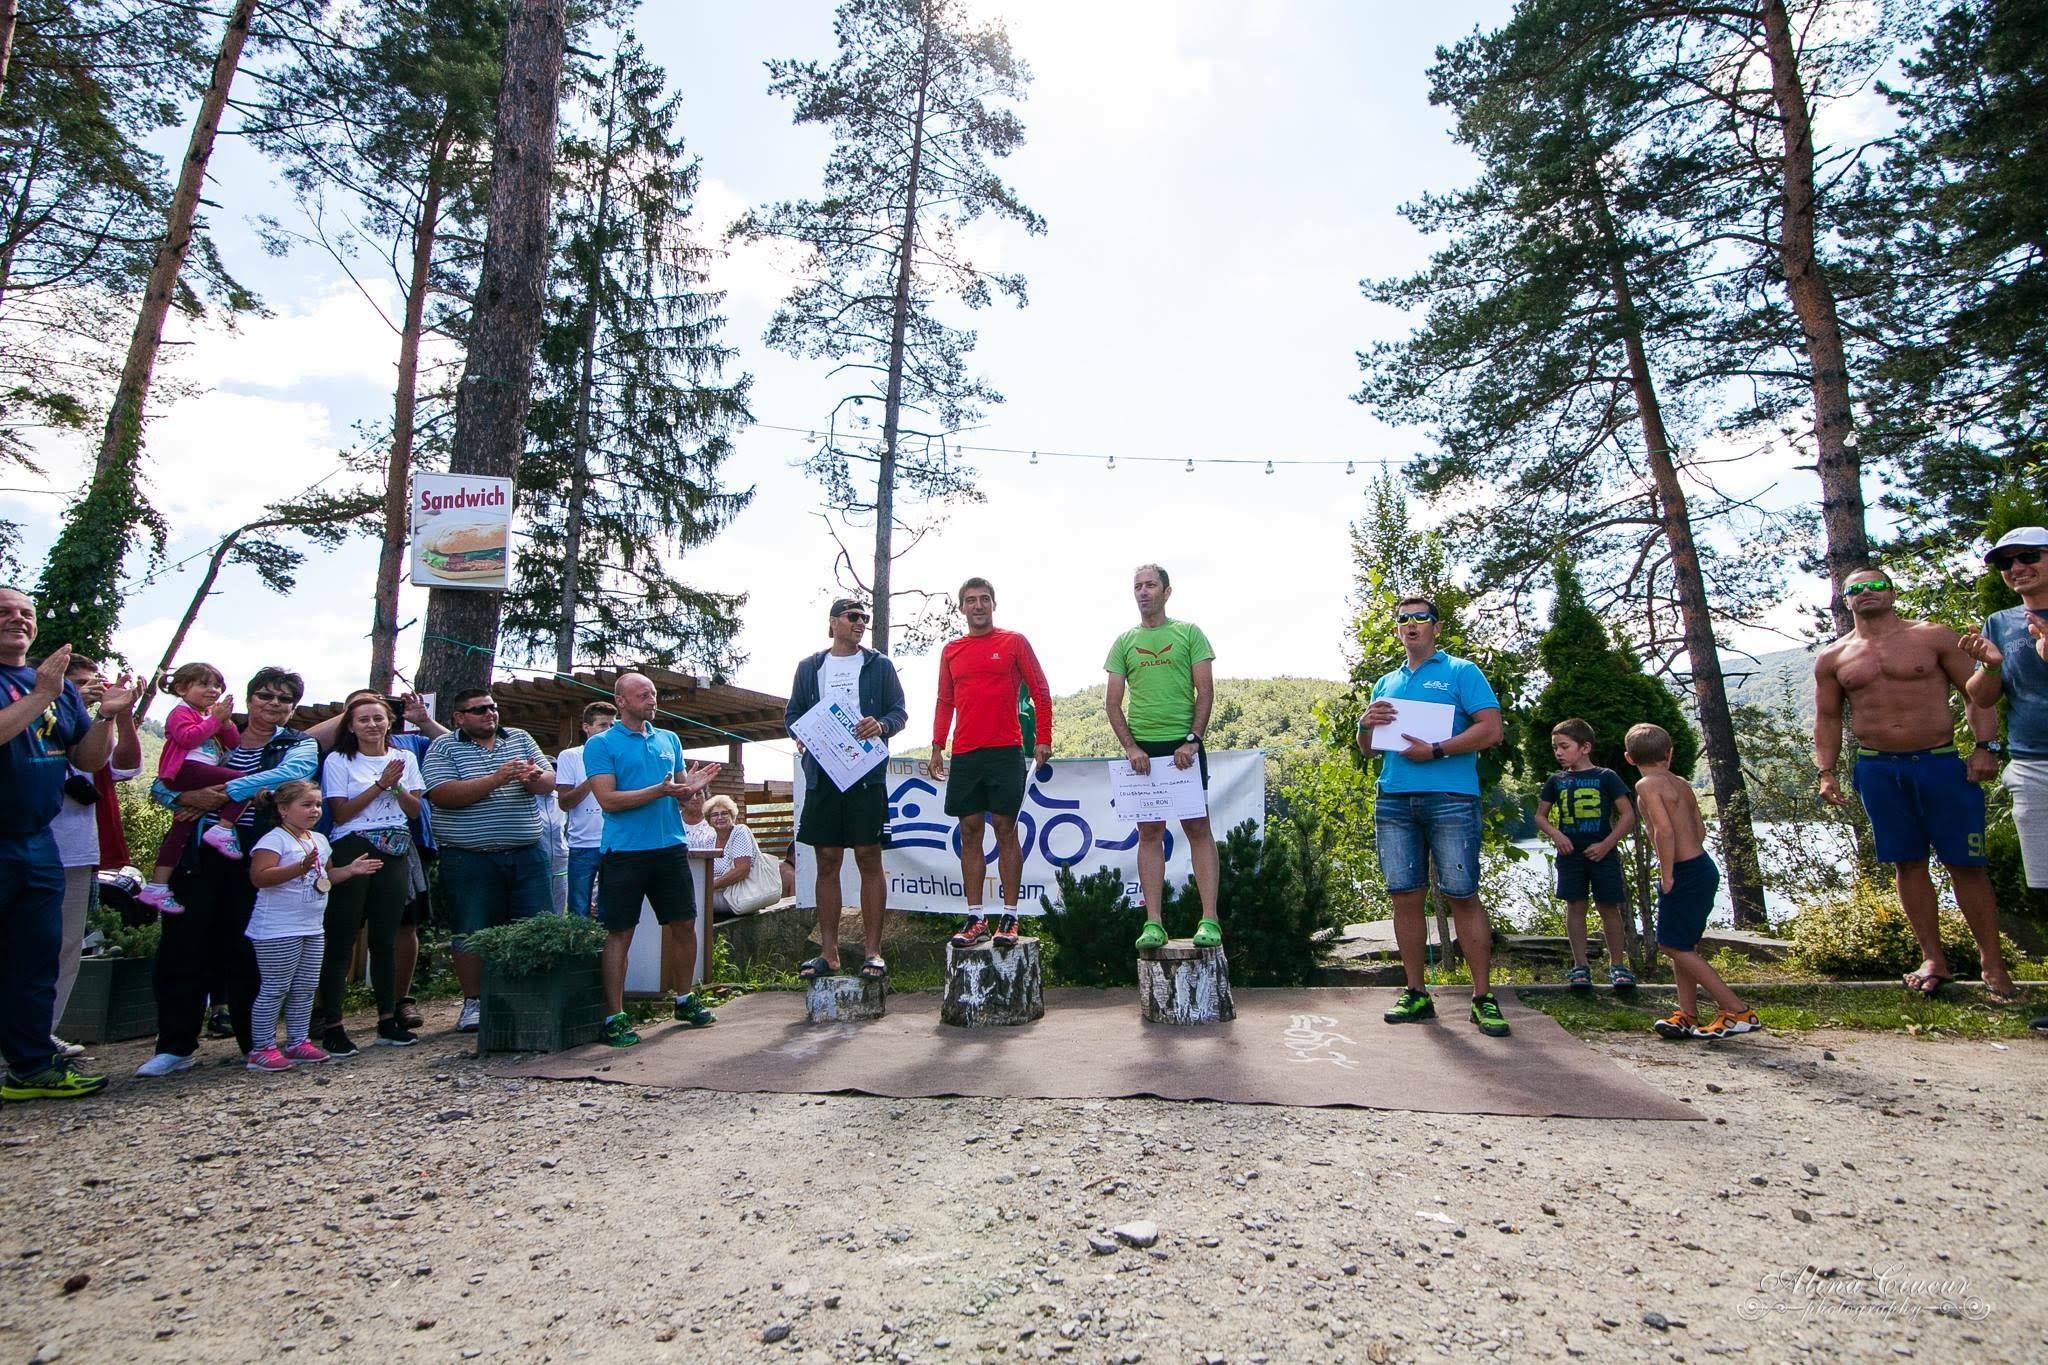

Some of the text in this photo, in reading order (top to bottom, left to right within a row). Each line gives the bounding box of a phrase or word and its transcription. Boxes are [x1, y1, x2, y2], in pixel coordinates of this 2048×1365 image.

[421, 485, 505, 511] Sandwich
[1140, 659, 1172, 667] SALEWA
[835, 709, 866, 748] DIPLOA
[889, 761, 913, 775] lub
[1560, 787, 1602, 824] 12
[885, 872, 968, 898] riathlo
